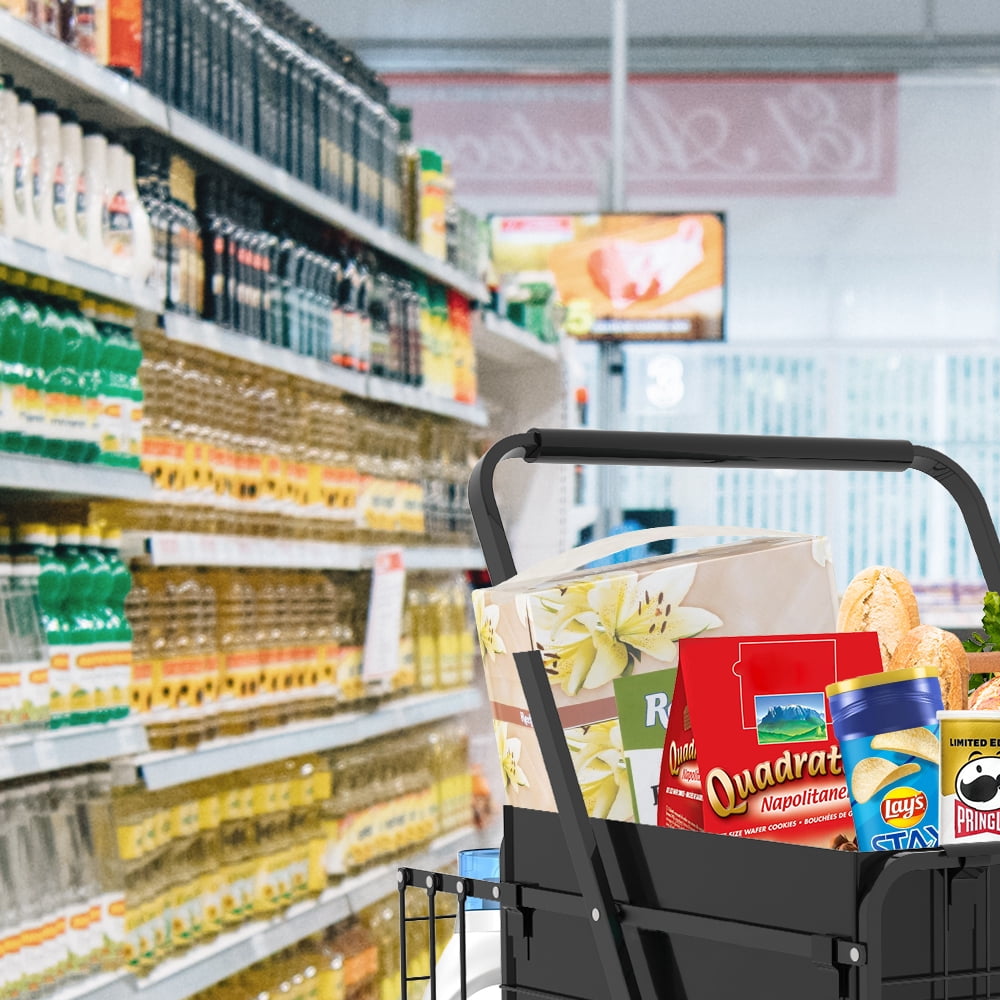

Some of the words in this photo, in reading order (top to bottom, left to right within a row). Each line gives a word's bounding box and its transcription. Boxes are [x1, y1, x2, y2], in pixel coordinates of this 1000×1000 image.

[646, 354, 685, 408] 3
[949, 738, 987, 747] LIMITED
[884, 795, 925, 819] Lay's
[744, 825, 767, 836] WAFER
[767, 821, 797, 831] COOKIES
[838, 811, 847, 819] DE
